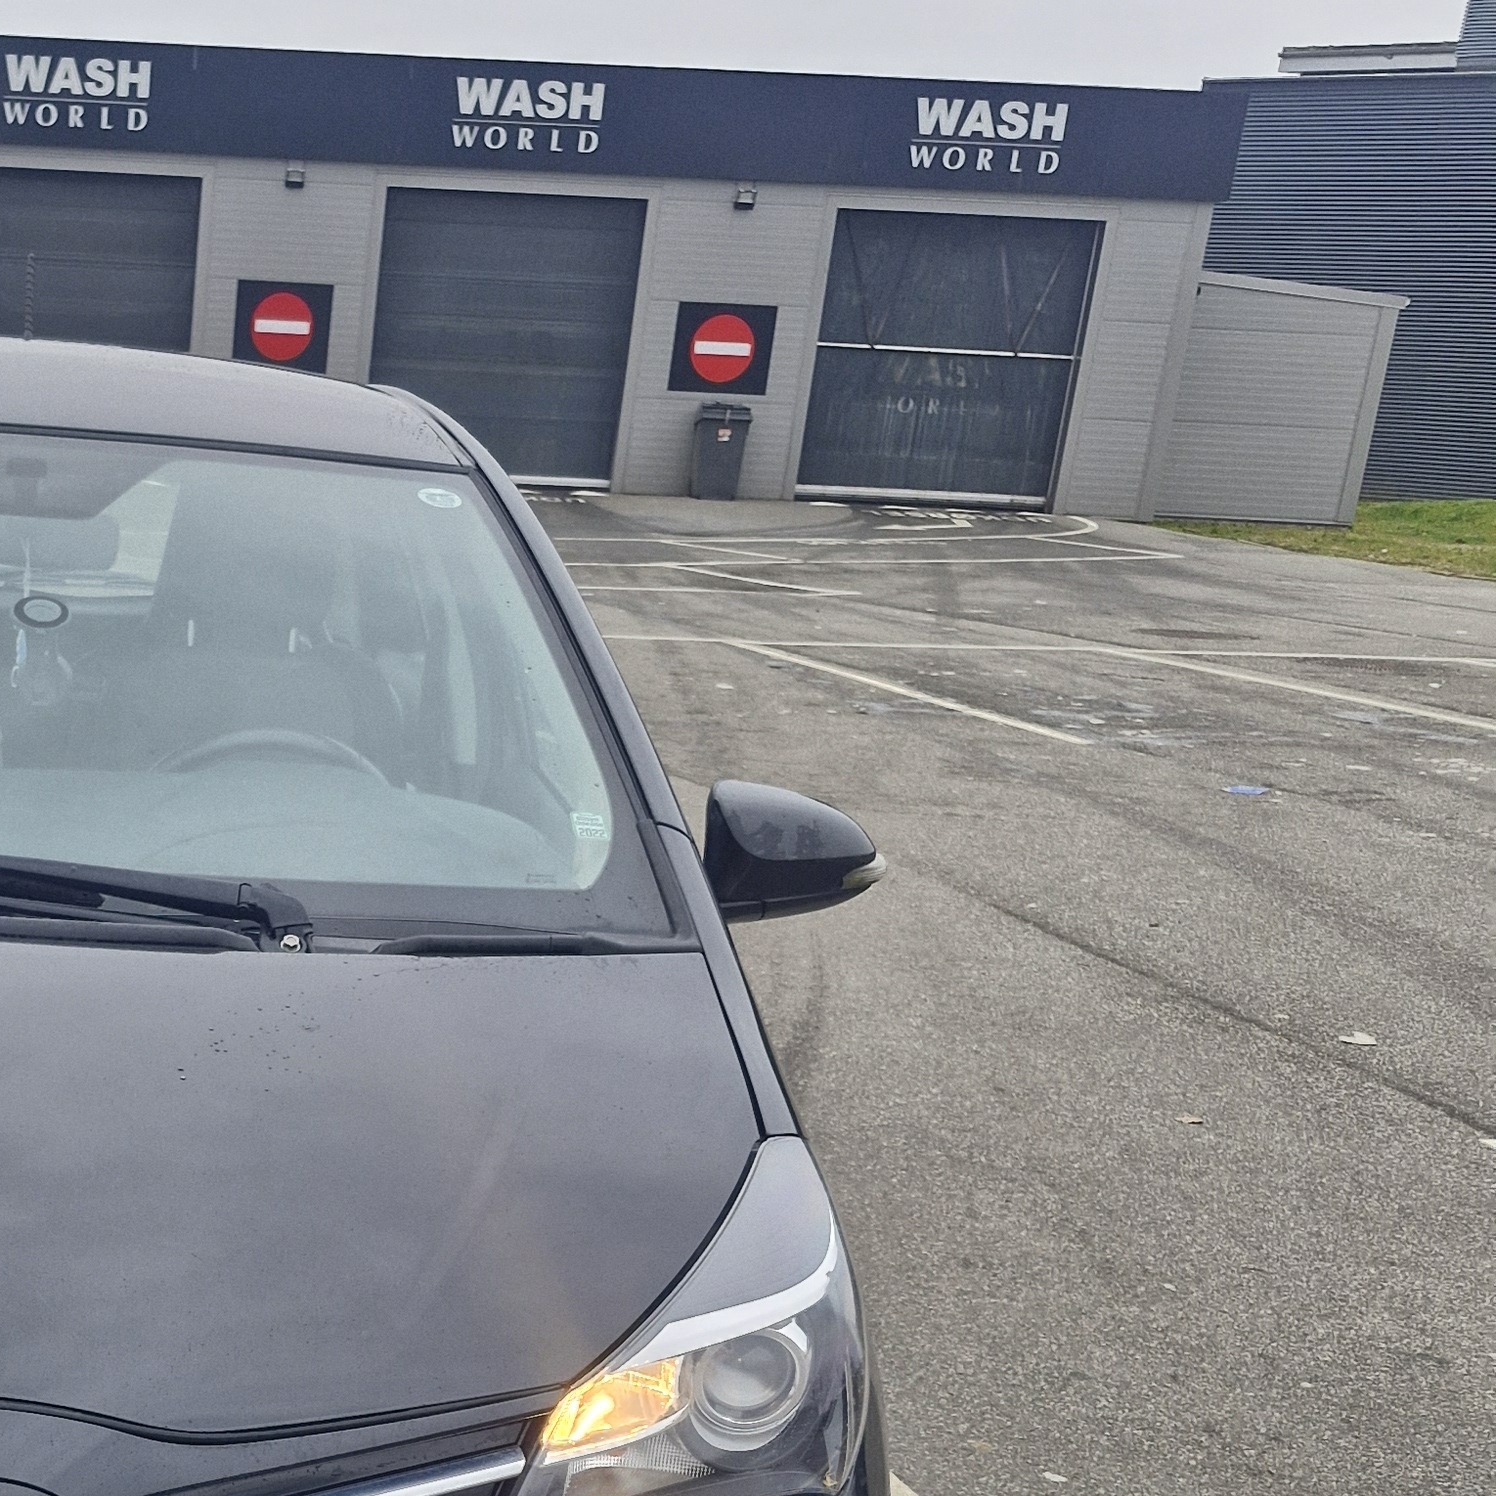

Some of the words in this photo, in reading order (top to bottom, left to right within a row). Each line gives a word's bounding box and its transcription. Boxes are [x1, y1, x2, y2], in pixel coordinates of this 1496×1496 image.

[5, 54, 152, 99] WASH
[3, 101, 149, 131] WORLD
[456, 76, 606, 121] WASH
[917, 97, 1069, 141] WASH
[452, 124, 599, 153] WORLD
[910, 145, 1060, 174] WORLD
